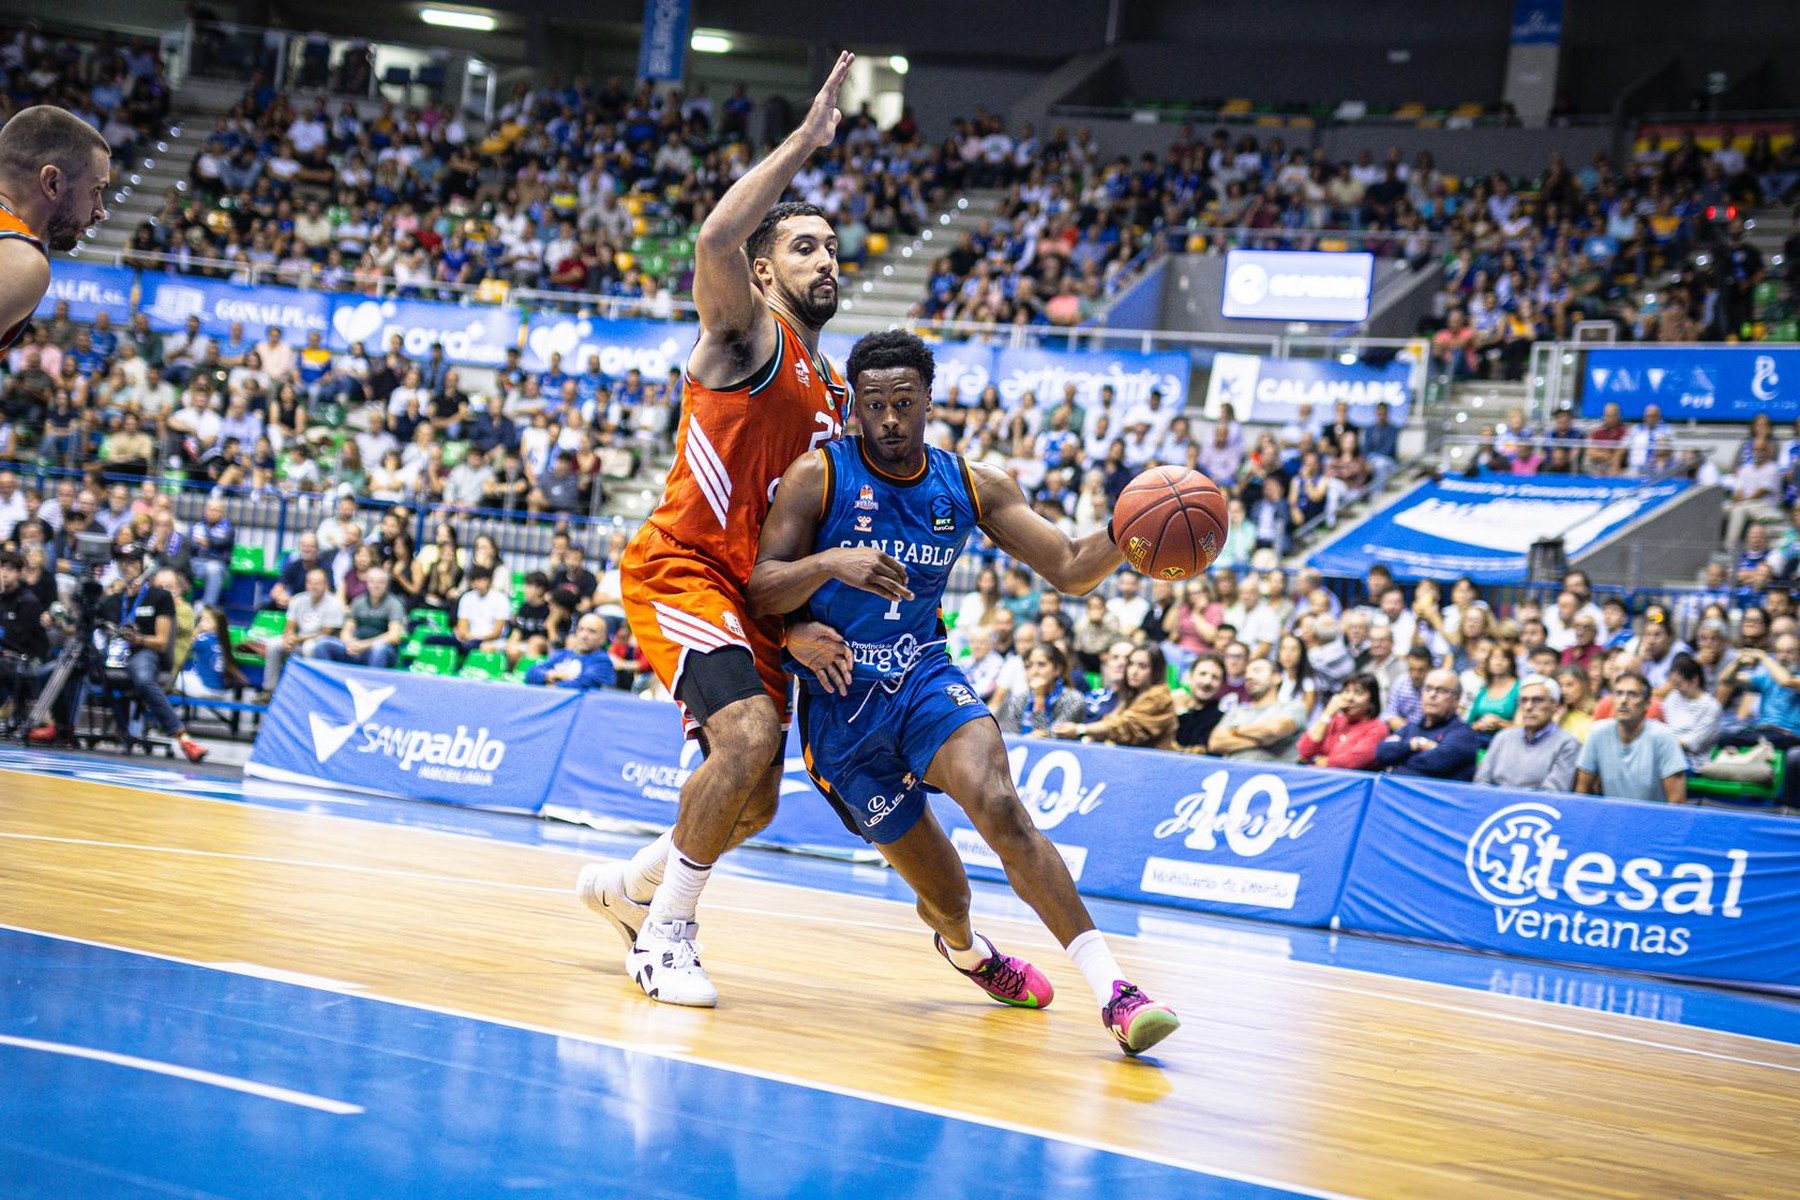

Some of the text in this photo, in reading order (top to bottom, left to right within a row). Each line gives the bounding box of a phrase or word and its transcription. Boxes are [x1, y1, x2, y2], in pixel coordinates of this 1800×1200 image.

[893, 541, 954, 566] PABLO
[864, 792, 905, 828] LEXUS
[1505, 825, 1749, 918] itesal
[1494, 907, 1692, 956] ventanas
